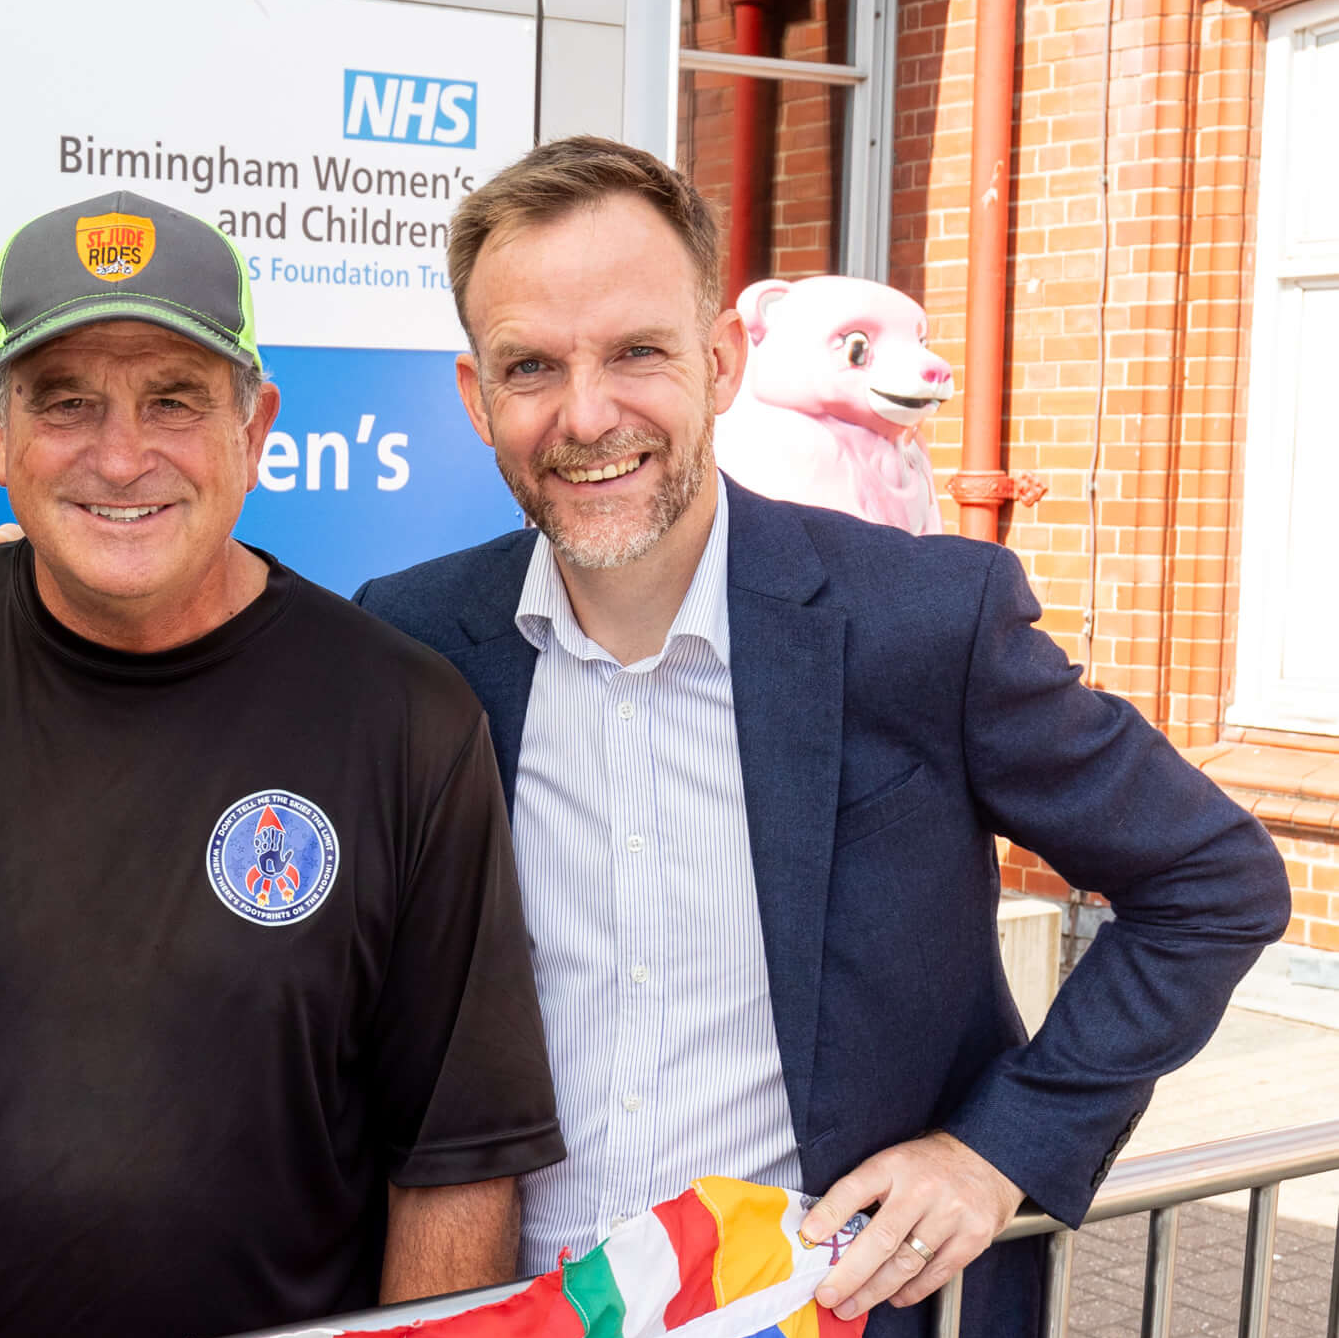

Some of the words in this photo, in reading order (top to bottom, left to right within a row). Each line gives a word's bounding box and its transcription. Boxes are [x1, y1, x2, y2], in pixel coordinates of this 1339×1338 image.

[345, 74, 474, 144] NHS
[59, 135, 299, 194] Birmingham
[313, 155, 475, 200] Women's
[218, 202, 287, 240] and
[302, 205, 448, 249] Children
[89, 246, 142, 266] RIDES
[270, 257, 409, 288] Foundation
[417, 264, 453, 289] Tru
[257, 413, 411, 493] en's
[217, 812, 238, 837] DON'T
[236, 801, 258, 815] TELL
[257, 796, 271, 805] ME
[272, 795, 289, 805] THE
[289, 799, 313, 816] SKIES
[311, 812, 326, 830] THE
[320, 828, 334, 851] LIMIT
[213, 848, 221, 874] WHEN
[216, 874, 240, 905] THERE'S
[304, 892, 320, 907] THE
[239, 902, 291, 919] FOOTPRINTS
[292, 904, 306, 915] ON
